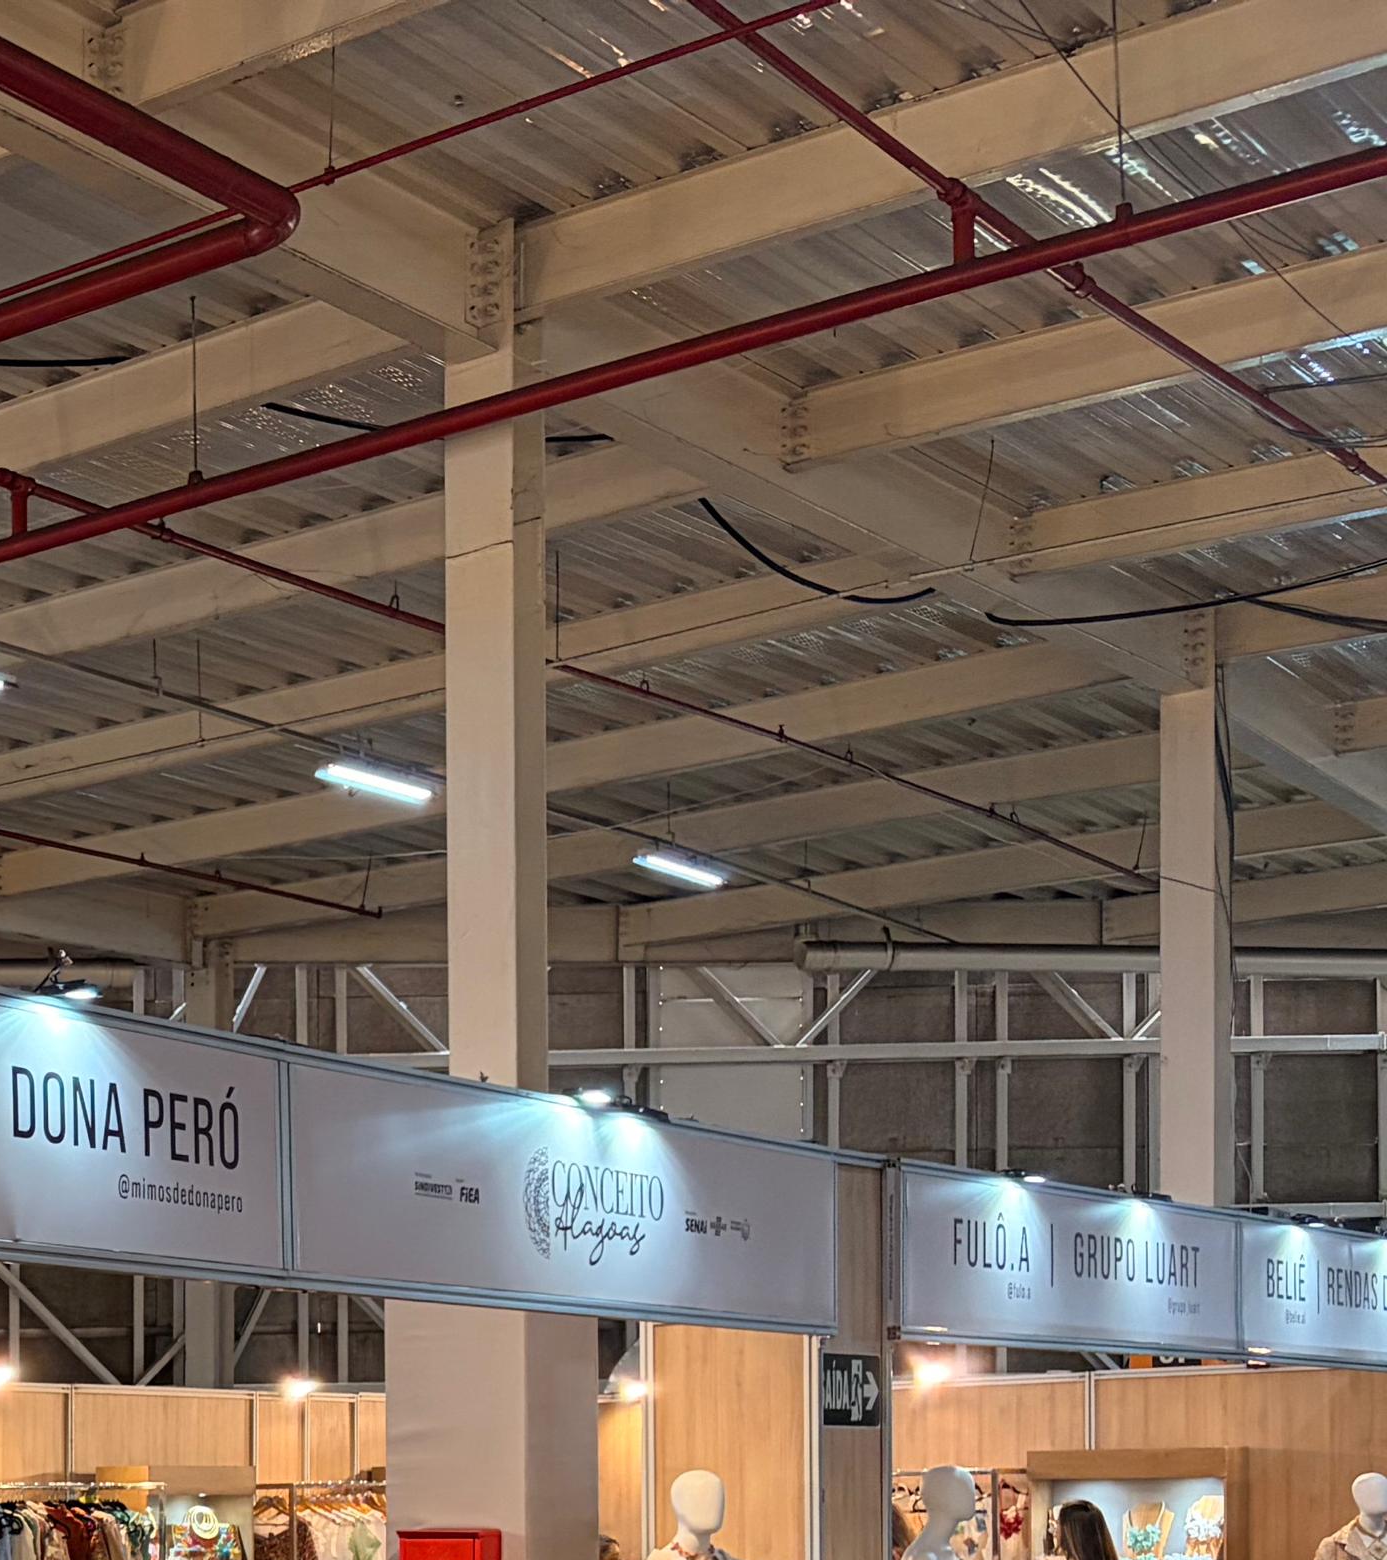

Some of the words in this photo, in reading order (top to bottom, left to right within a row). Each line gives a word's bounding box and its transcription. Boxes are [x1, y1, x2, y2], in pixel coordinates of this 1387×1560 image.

[11, 1066, 127, 1154] DONA
[143, 1085, 240, 1170] PERÓ
[118, 1173, 243, 1214] @mimosdedonapero
[551, 1160, 664, 1222] CONCEITO
[554, 1182, 646, 1266] Alagoas
[953, 1212, 1031, 1273] FULÔ.A
[1073, 1232, 1136, 1282] GRUPO
[1145, 1240, 1200, 1289] LUART
[1266, 1254, 1306, 1302] BELIÊ
[1327, 1266, 1379, 1311] RENDAS
[824, 1360, 850, 1409] AÍDA
